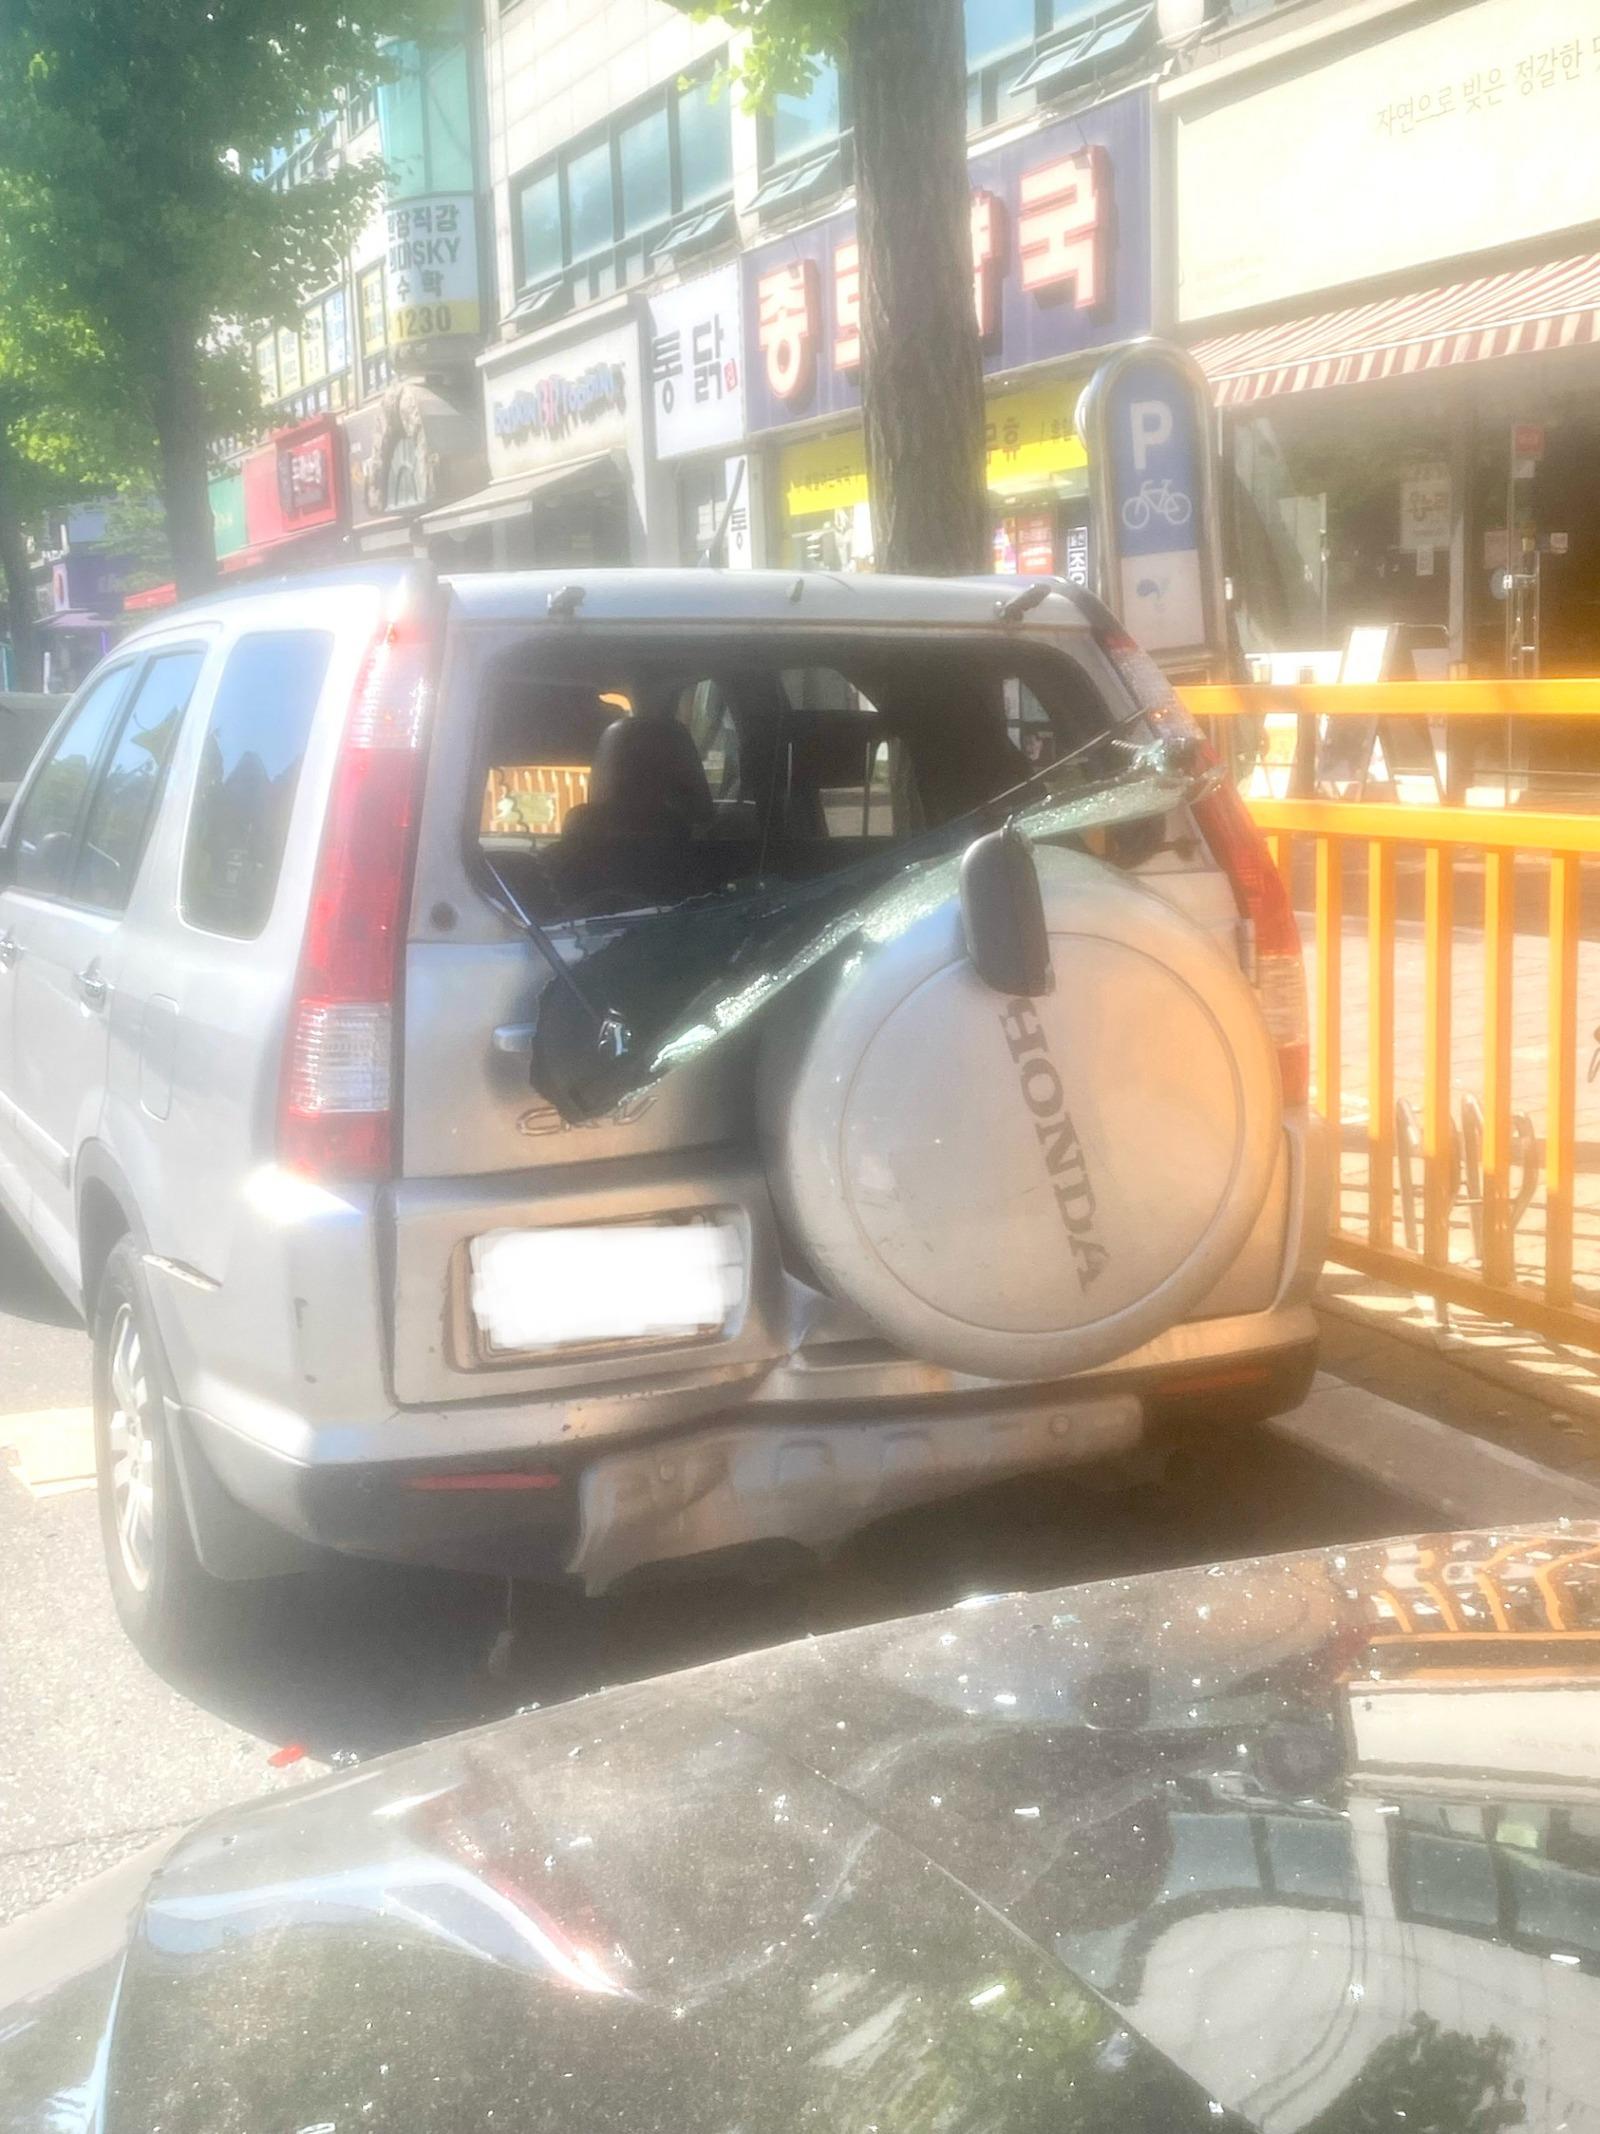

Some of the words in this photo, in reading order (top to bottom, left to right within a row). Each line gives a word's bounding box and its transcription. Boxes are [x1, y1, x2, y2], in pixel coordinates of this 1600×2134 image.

[1377, 86, 1456, 135] 자연으로
[1516, 39, 1583, 96] 정갈한
[757, 144, 1104, 398] 종국
[396, 304, 452, 338] 1230
[652, 313, 724, 414] 통닭
[1130, 401, 1173, 470] P
[999, 998, 1110, 1293] HONDA
